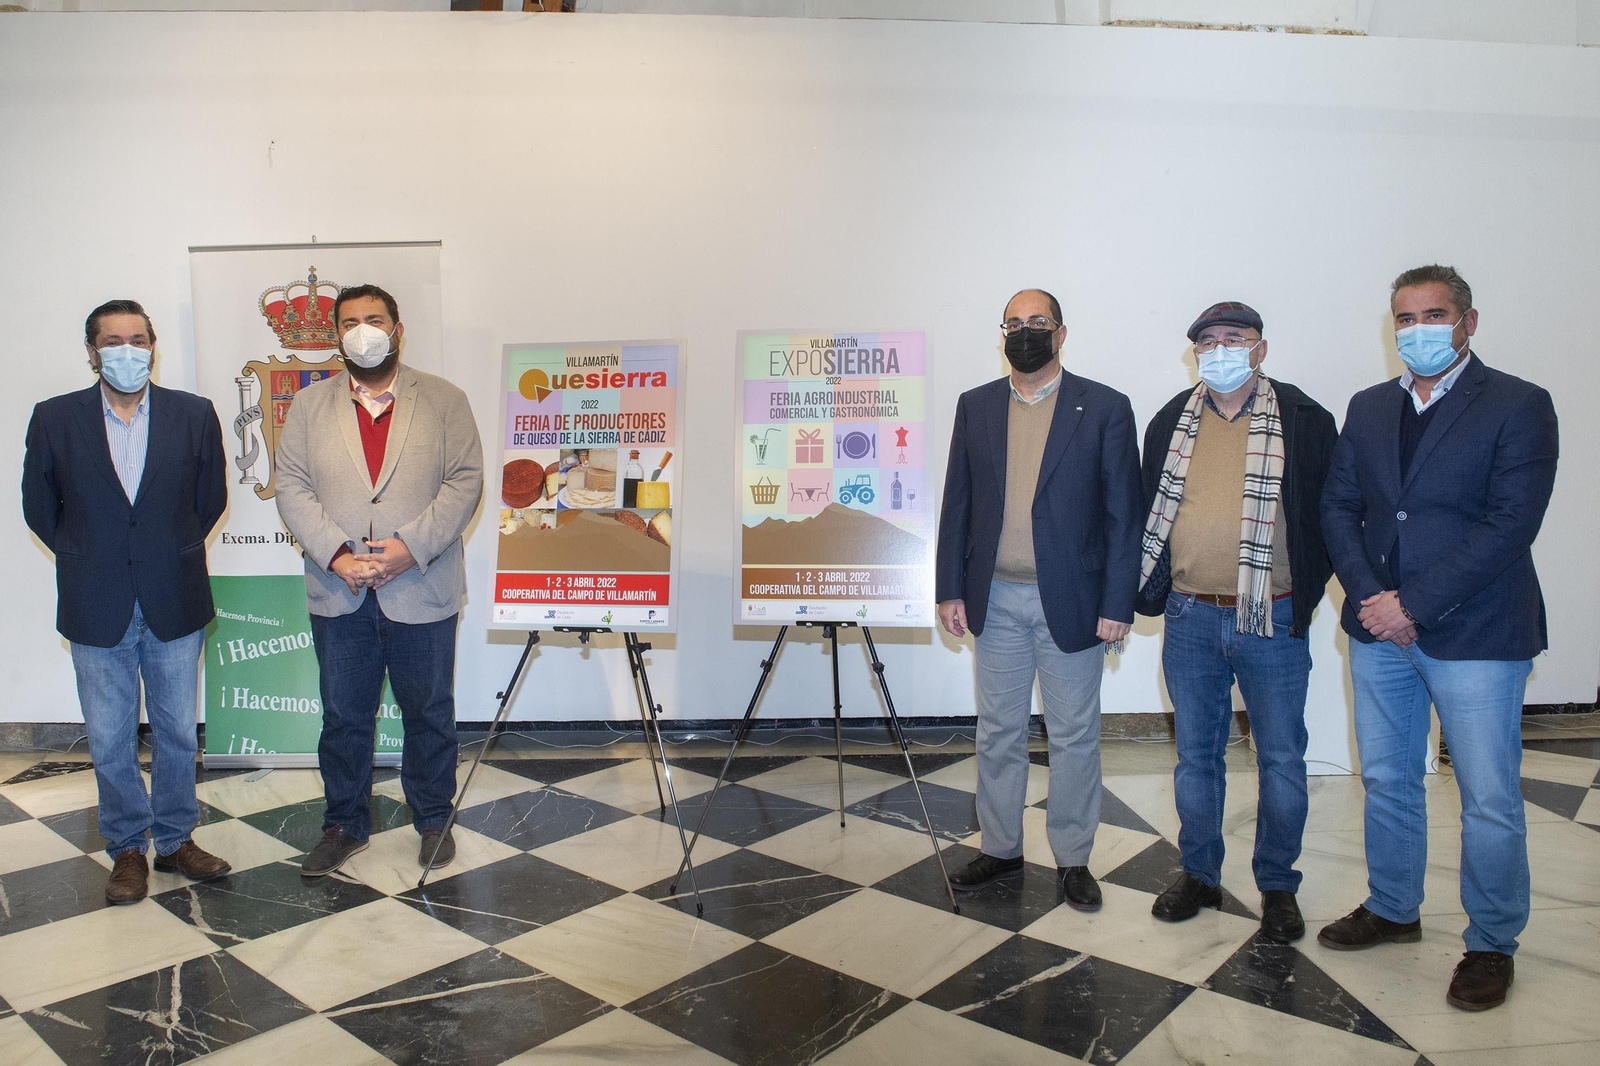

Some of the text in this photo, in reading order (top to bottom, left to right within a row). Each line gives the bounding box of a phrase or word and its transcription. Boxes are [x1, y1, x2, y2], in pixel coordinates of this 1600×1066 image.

[810, 336, 858, 348] VILLAMARTÍN
[566, 354, 619, 368] VILLAMARTÍN
[769, 348, 900, 376] EXPOSIERRA
[826, 377, 841, 385] 2022
[581, 400, 599, 409] 2022
[770, 390, 898, 406] FERIA AGROINDUSTRIAL
[770, 404, 899, 419] COMERCIAL Y GASTRONÓMICA
[515, 412, 666, 431] FERIA DE PRODUCTORES
[514, 428, 666, 446] DE QUESO DE LA SIERRA DE CÁDIZ
[222, 533, 270, 544] Excma.
[546, 577, 550, 587] 1
[556, 577, 561, 587] 2
[567, 578, 572, 587] 3
[574, 578, 595, 587] ABRIL
[597, 578, 616, 588] 2022
[796, 572, 800, 582] 1
[806, 572, 811, 582] 2
[818, 572, 823, 582] 3
[825, 572, 848, 582] ABRIL
[850, 572, 870, 583] 2022
[502, 588, 657, 601] COOPERATIVA DEL CAMPO DE VILLAMARTÍN
[750, 584, 912, 596] COOPERATIVA DEL CAMPO DE VILLAMART
[216, 608, 246, 621] Hacemos
[247, 614, 280, 627] Provincia
[232, 687, 319, 714] Hacemos
